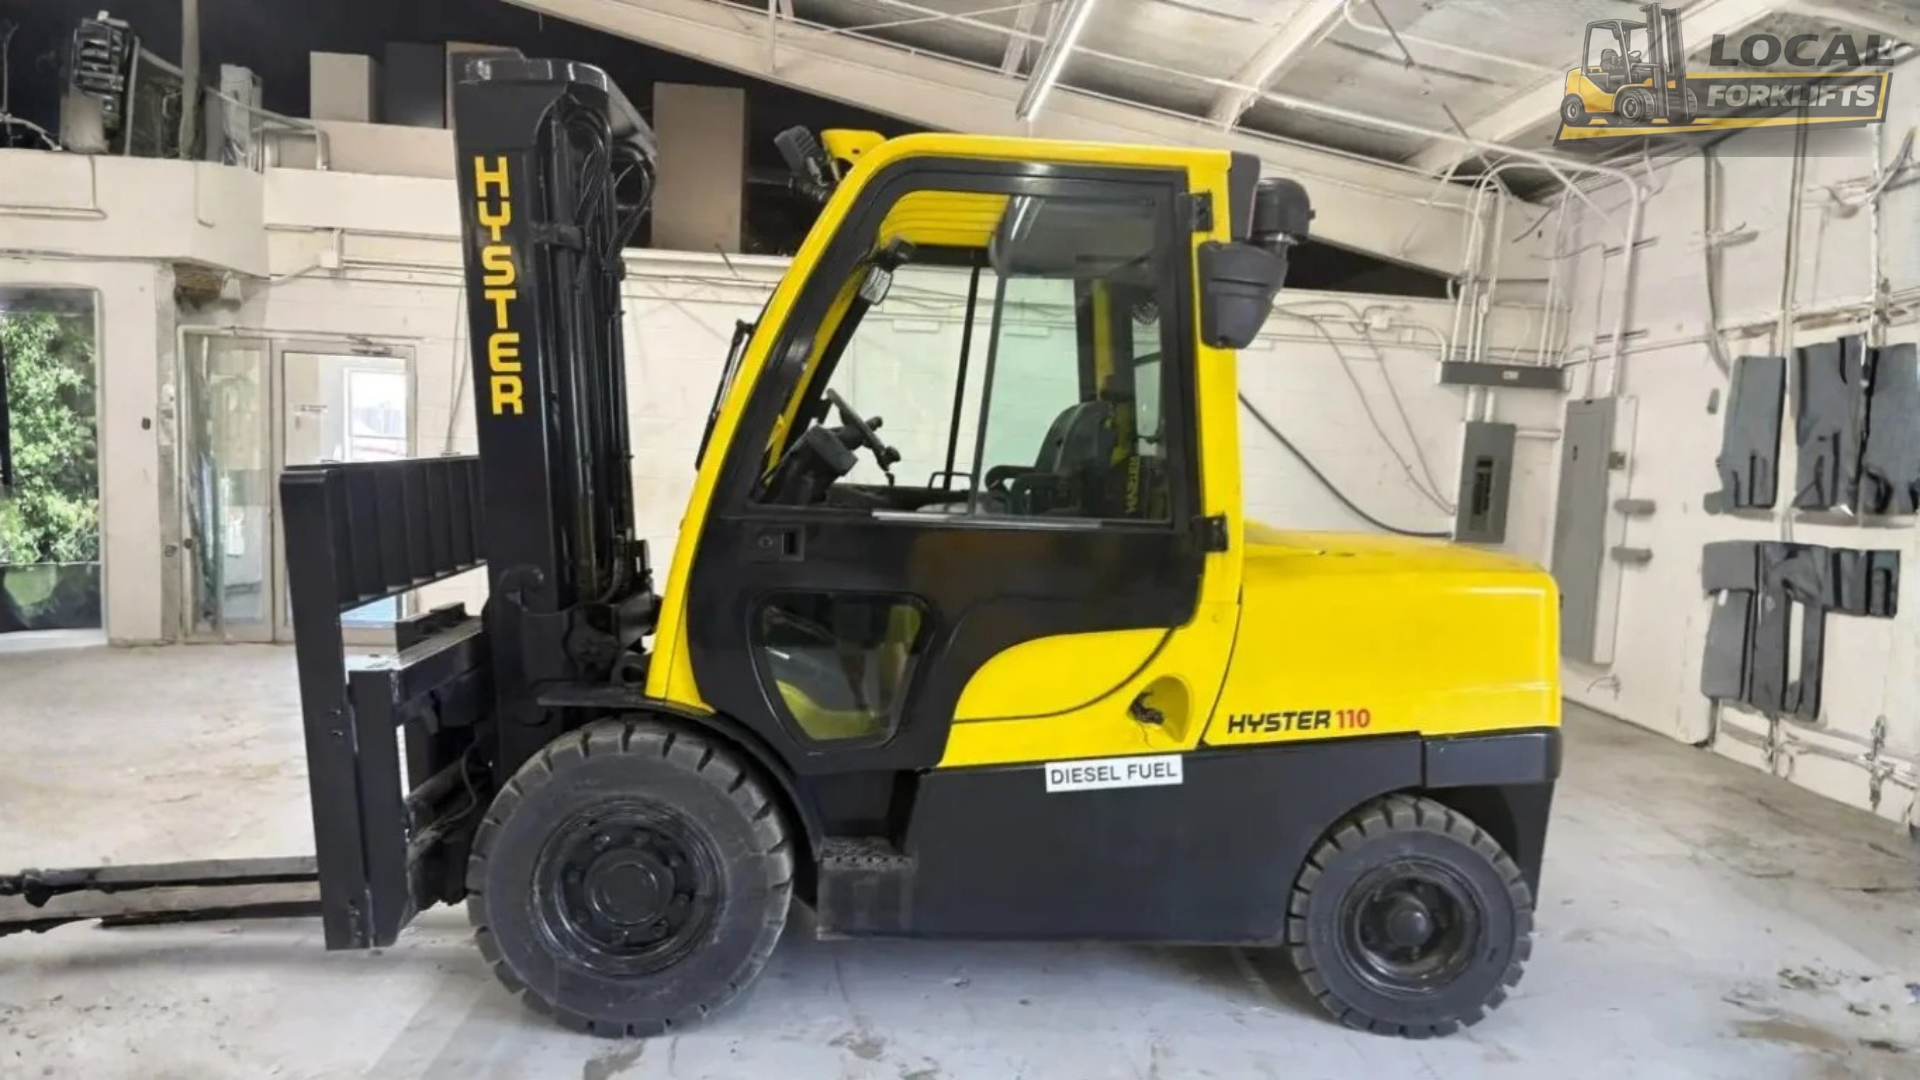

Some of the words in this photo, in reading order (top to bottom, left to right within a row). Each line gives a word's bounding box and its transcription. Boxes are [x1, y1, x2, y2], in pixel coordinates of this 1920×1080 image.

[474, 156, 523, 415] HYSTER
[1227, 710, 1331, 733] HYSTER
[1335, 708, 1370, 729] 110
[1051, 765, 1121, 785] DIESEL
[1127, 762, 1178, 779] FUEL
